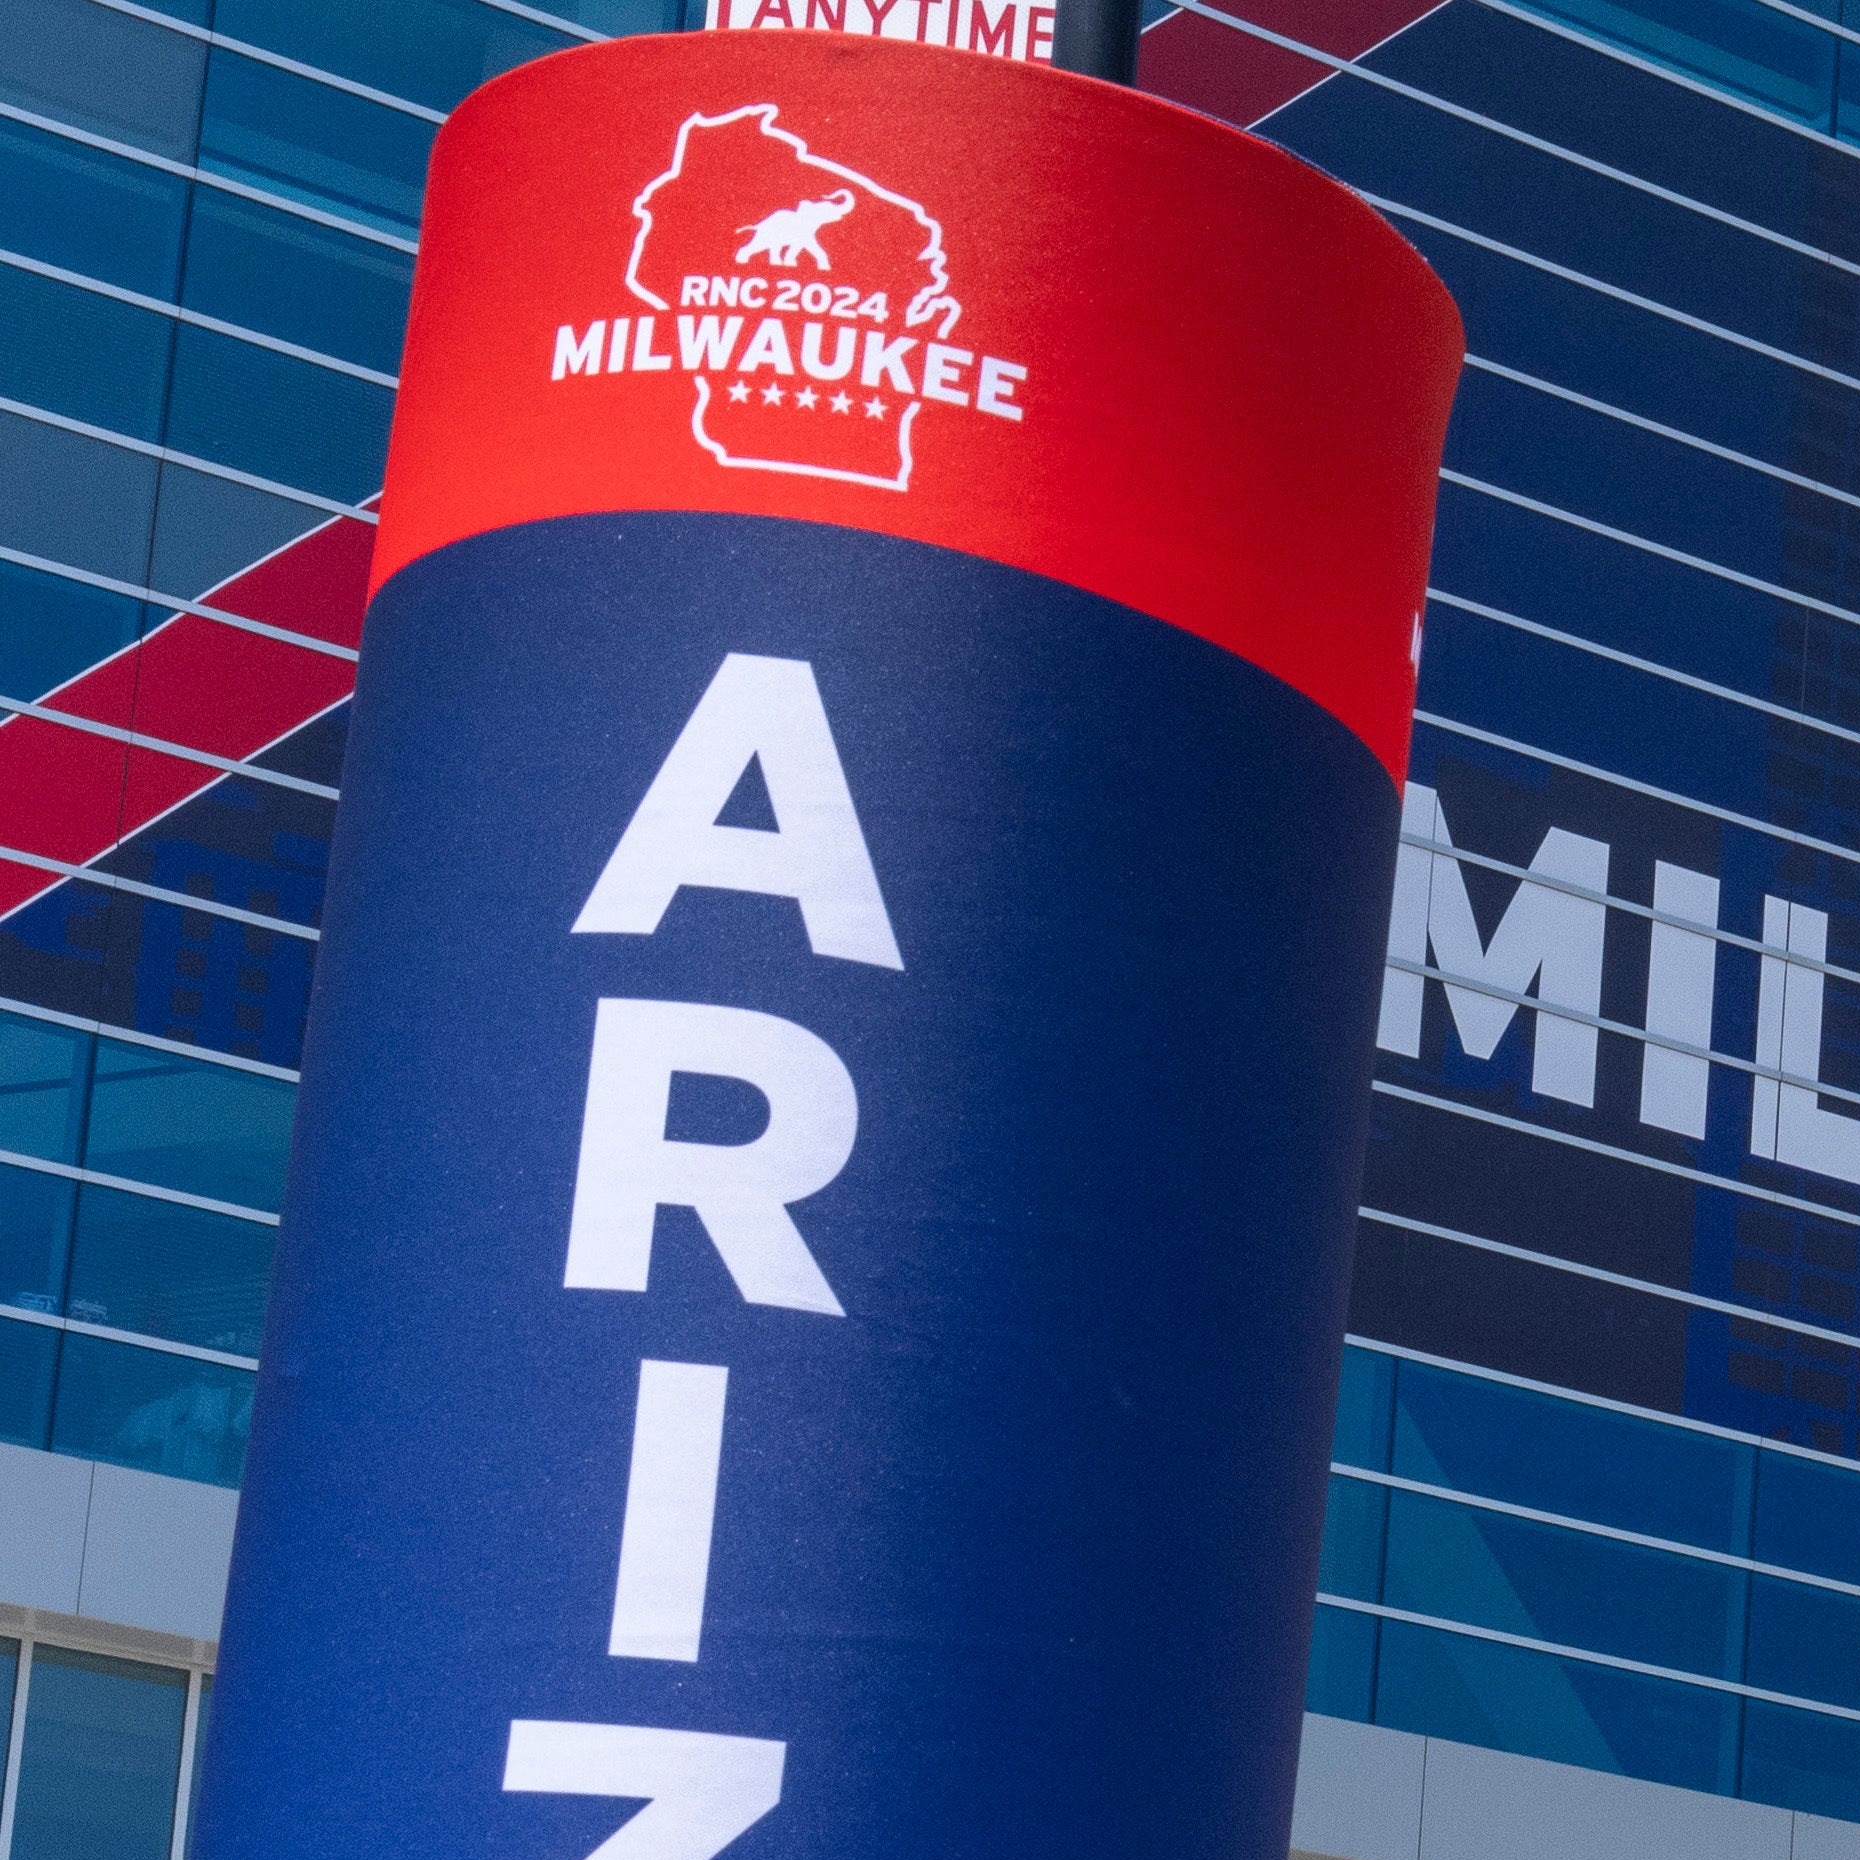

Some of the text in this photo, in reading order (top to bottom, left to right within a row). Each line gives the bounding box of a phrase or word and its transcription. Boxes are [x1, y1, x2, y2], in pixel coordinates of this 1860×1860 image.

[680, 275, 889, 323] RNC 2024
[551, 314, 1029, 421] MILWAUKEE
